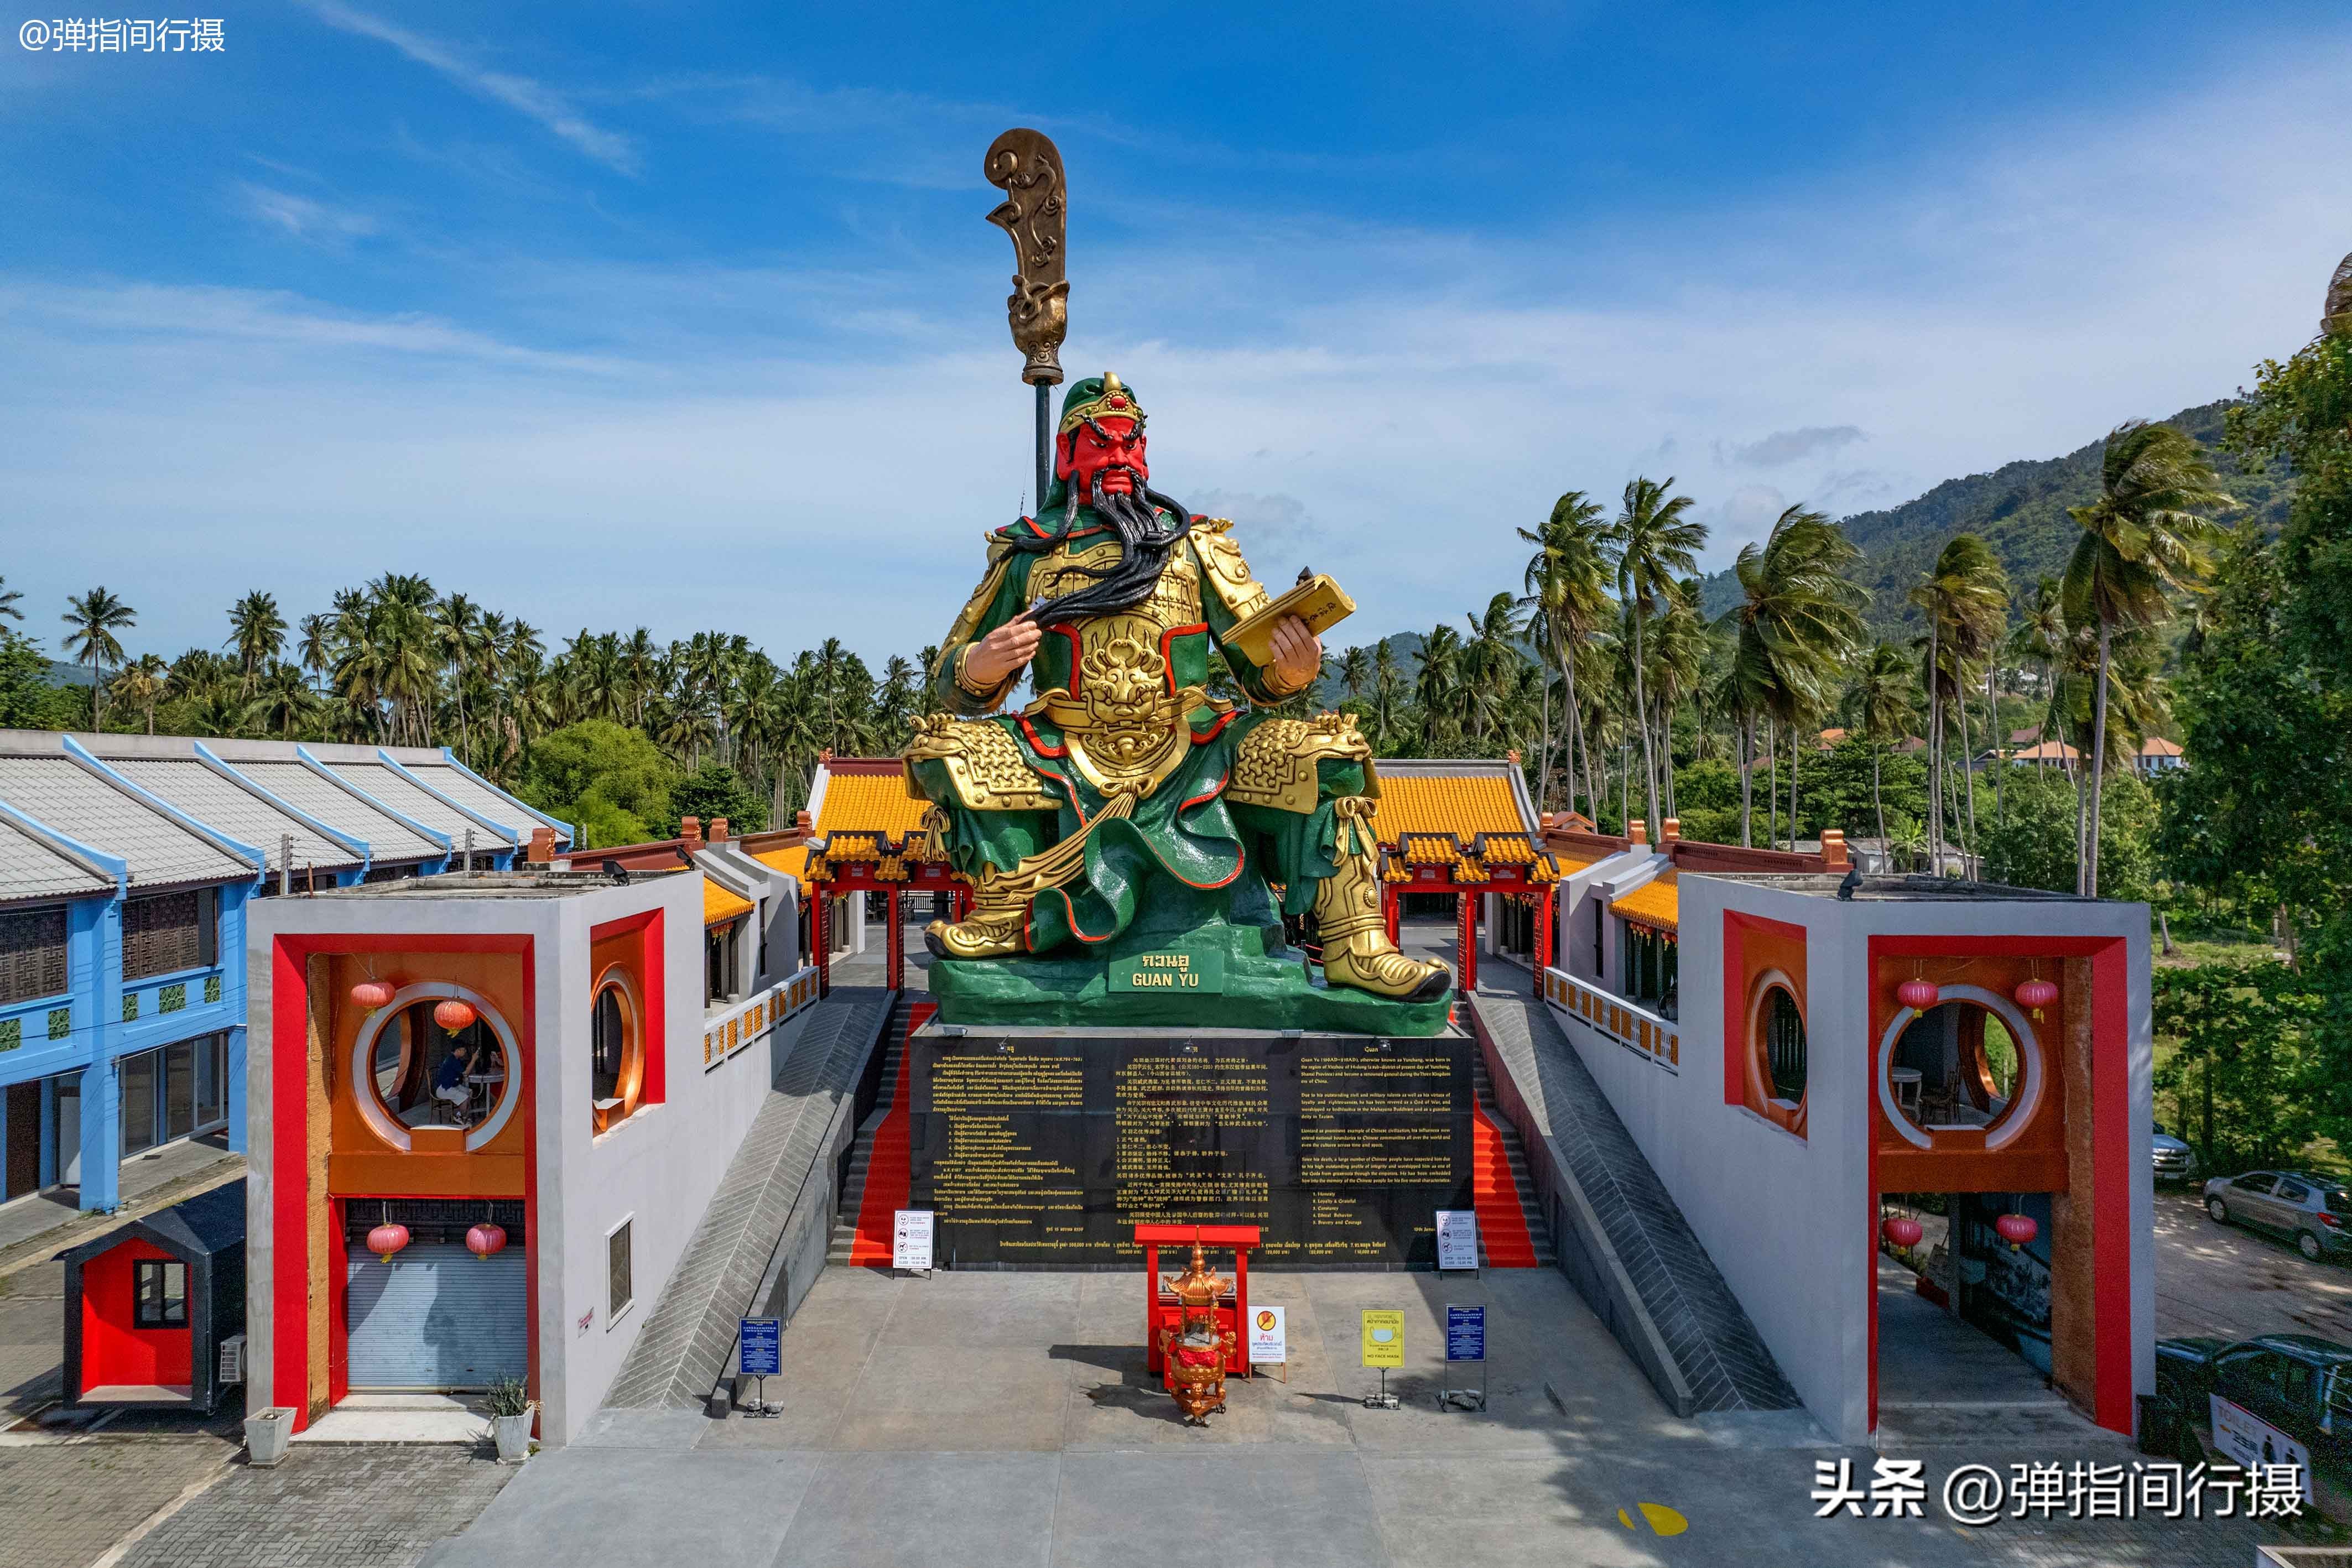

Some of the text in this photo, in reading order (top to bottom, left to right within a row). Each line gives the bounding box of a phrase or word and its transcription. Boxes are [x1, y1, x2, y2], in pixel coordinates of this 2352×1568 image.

[1142, 955, 1189, 972] กวนอู
[1132, 973, 1199, 987] GUAN YU
